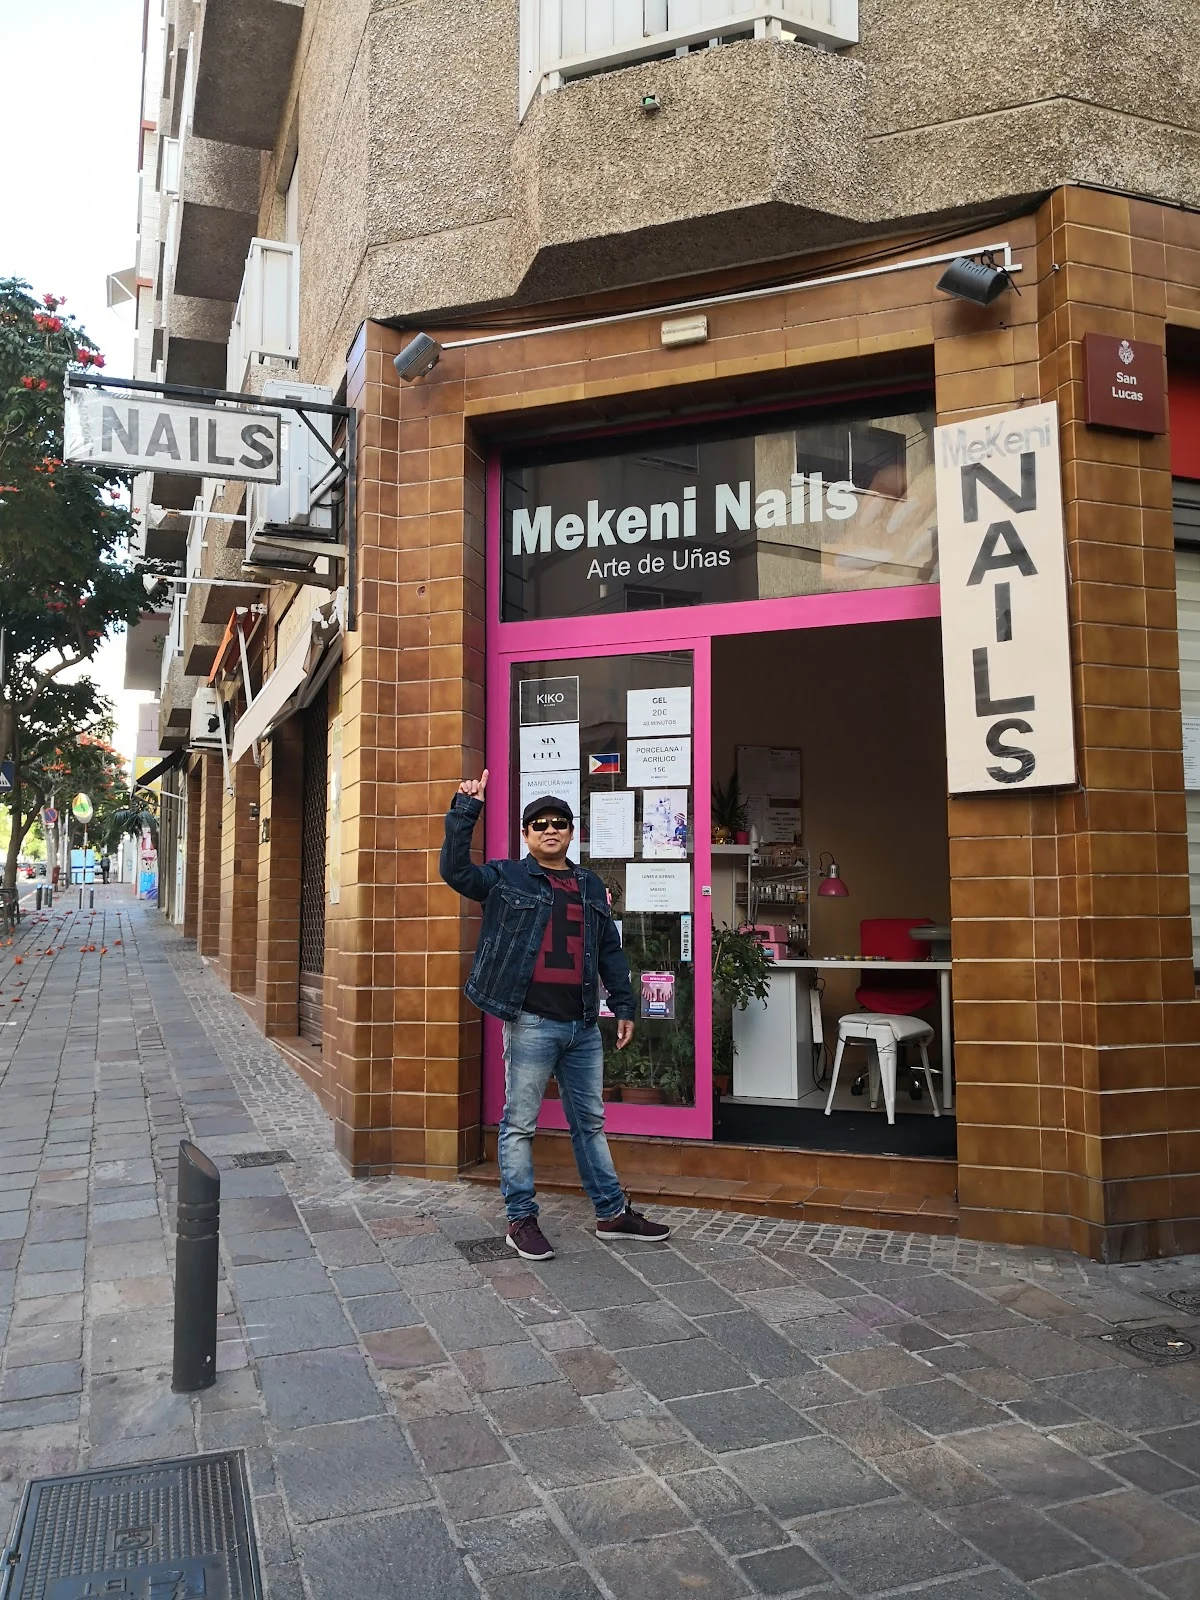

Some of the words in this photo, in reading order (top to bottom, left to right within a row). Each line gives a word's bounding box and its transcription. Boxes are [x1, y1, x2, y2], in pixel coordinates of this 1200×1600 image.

[1116, 371, 1137, 385] San
[1111, 386, 1144, 402] Lucas
[101, 405, 275, 470] NAILS
[512, 486, 697, 556] Mekeni
[714, 472, 859, 534] Nails
[586, 556, 631, 580] Arte
[637, 553, 665, 574] de
[671, 547, 731, 572] Uñas
[960, 451, 1039, 784] NAILS
[536, 692, 564, 704] KIKO
[541, 737, 556, 745] SIN
[636, 746, 679, 754] PORCELANA
[642, 755, 677, 763] ACRILICO
[527, 779, 560, 788] MANICURA
